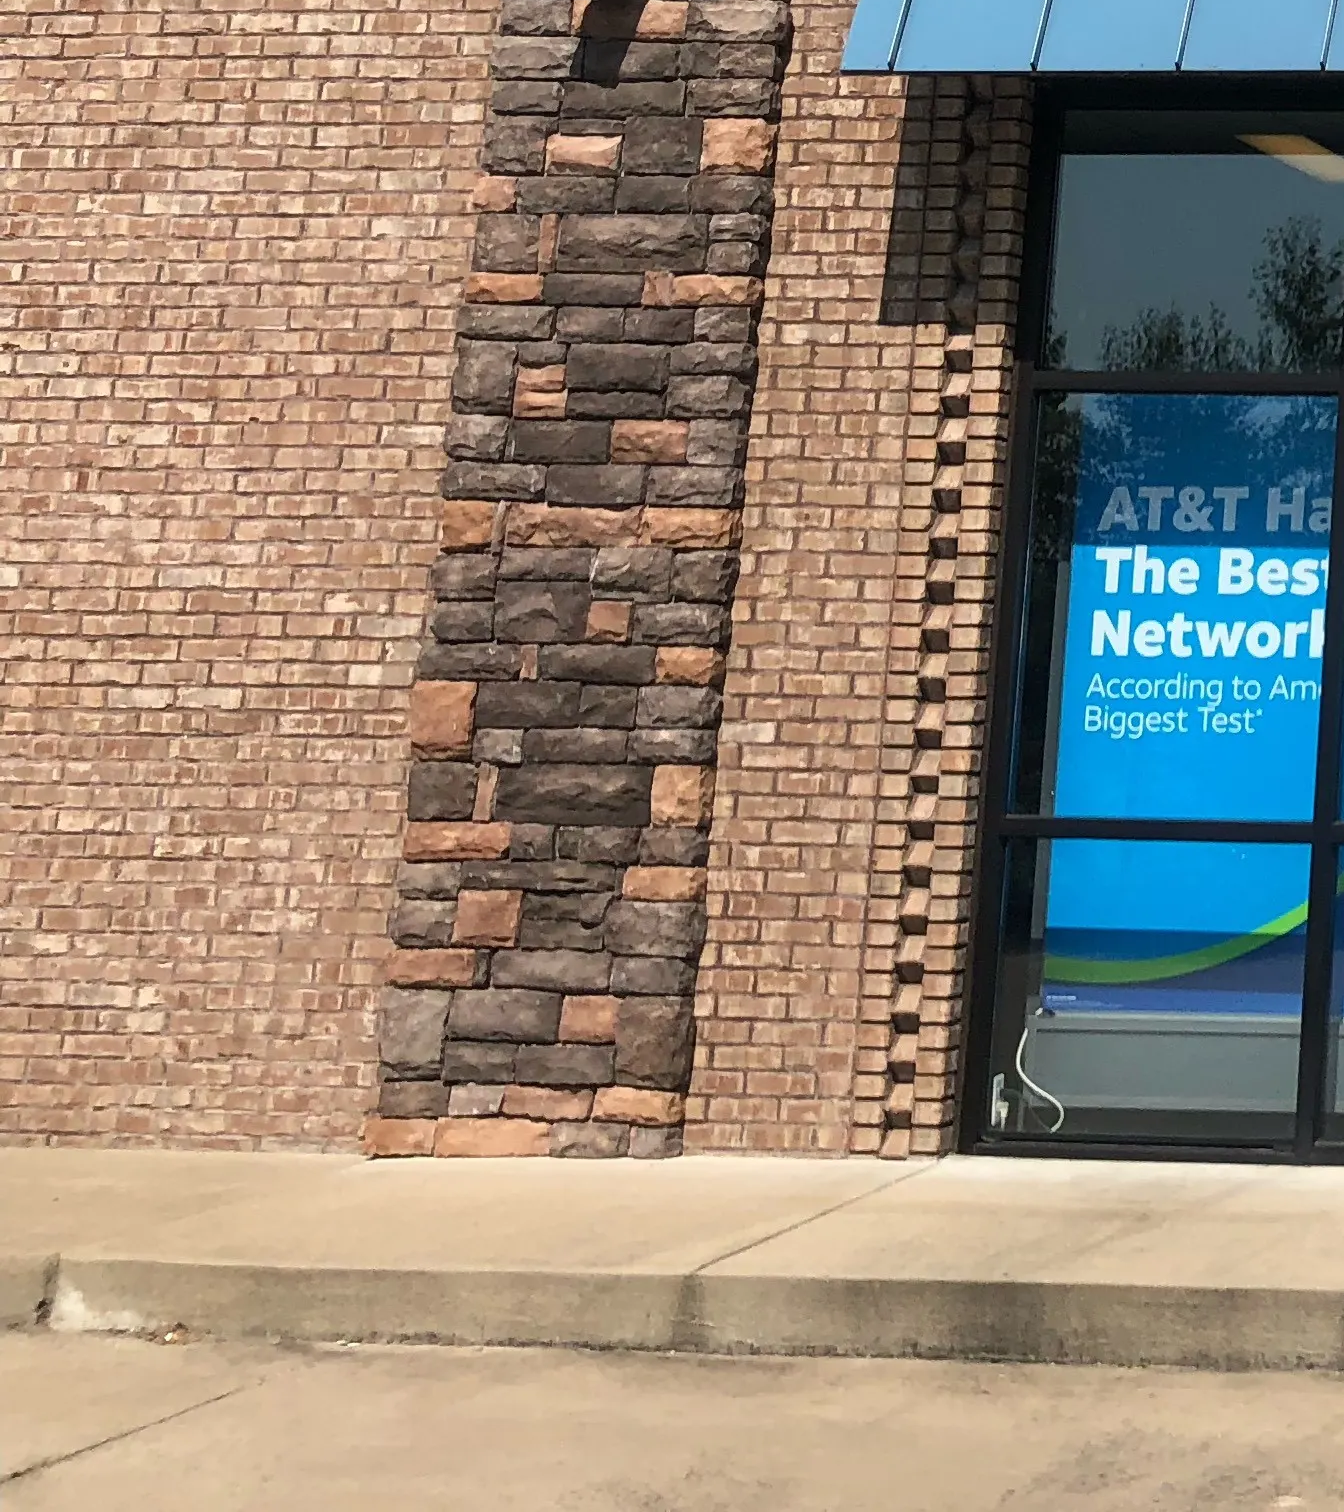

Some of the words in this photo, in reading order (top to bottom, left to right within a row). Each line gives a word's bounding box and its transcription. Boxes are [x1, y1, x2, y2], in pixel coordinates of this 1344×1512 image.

[1097, 486, 1249, 532] AT&T
[1095, 545, 1200, 596] The
[1085, 672, 1224, 707] According
[1231, 676, 1262, 701] to
[1084, 705, 1189, 740] Biggest
